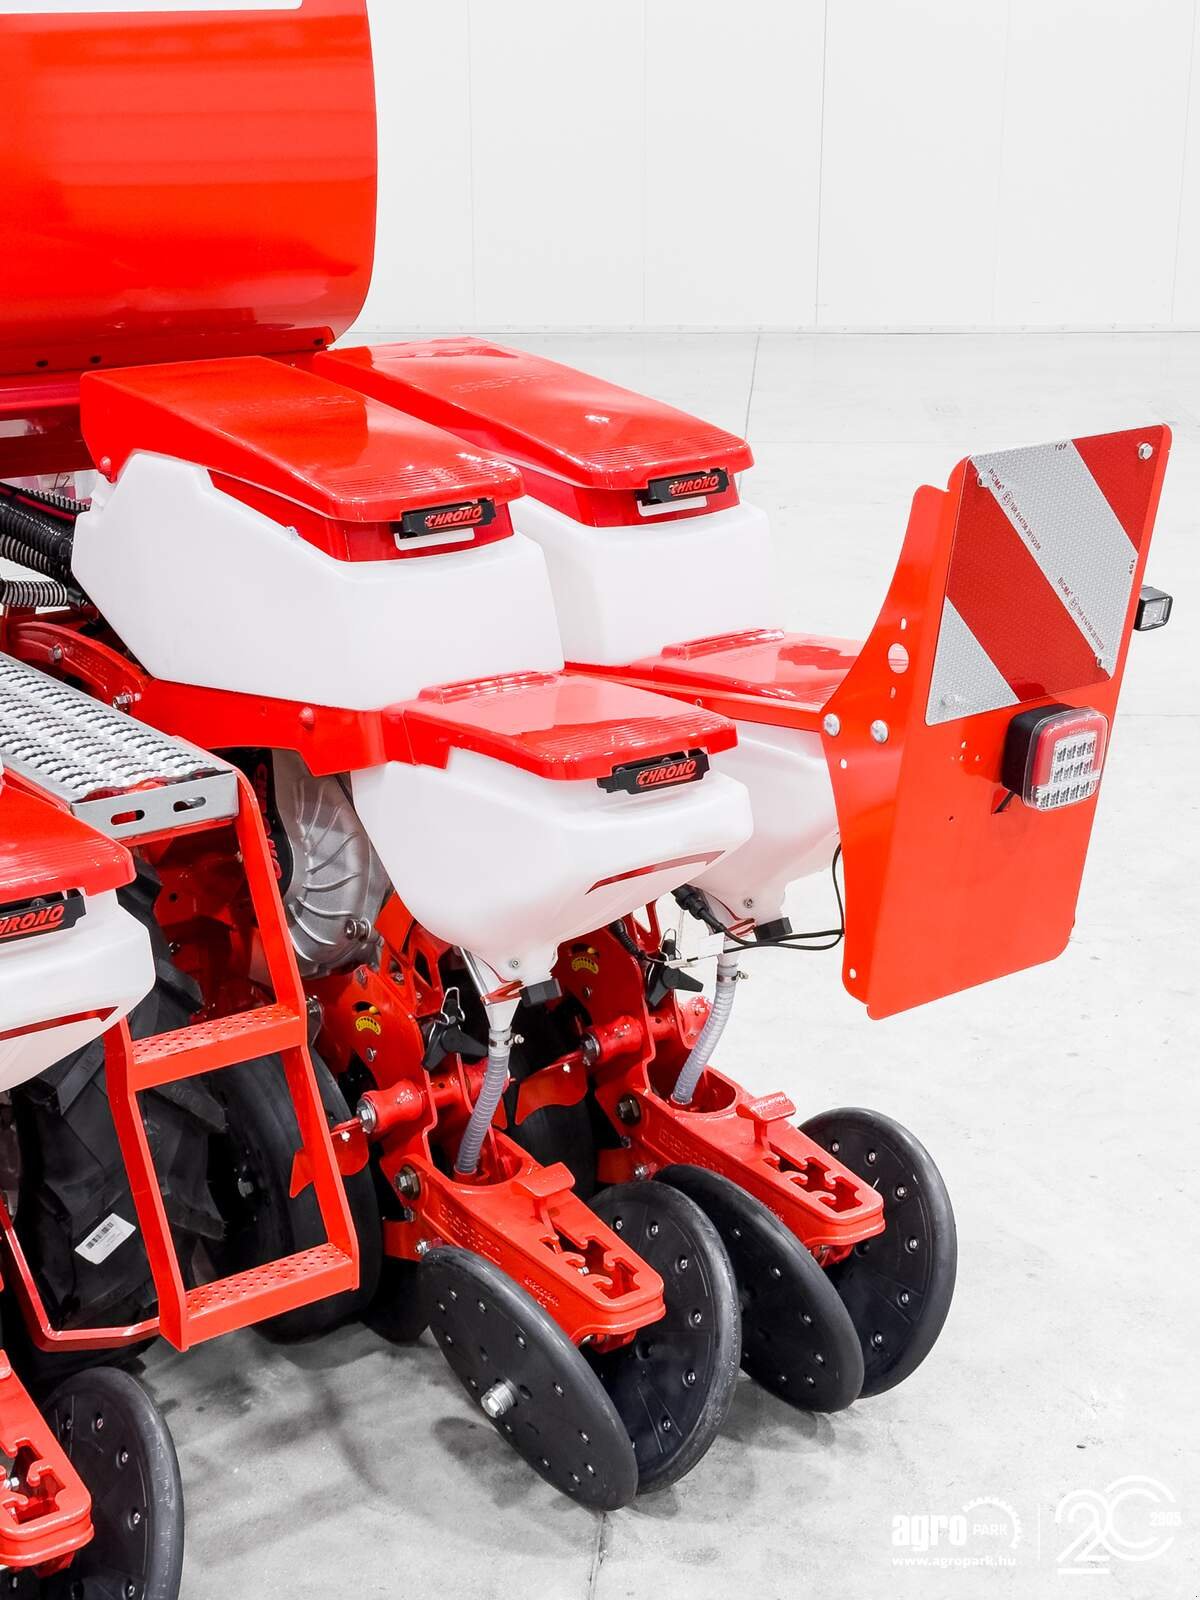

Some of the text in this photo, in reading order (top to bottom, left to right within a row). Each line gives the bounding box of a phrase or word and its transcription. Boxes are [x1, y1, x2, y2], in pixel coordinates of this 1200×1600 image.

[668, 475, 719, 496] CHRONO
[424, 505, 483, 529] CHRONO
[636, 759, 697, 785] CHRONO
